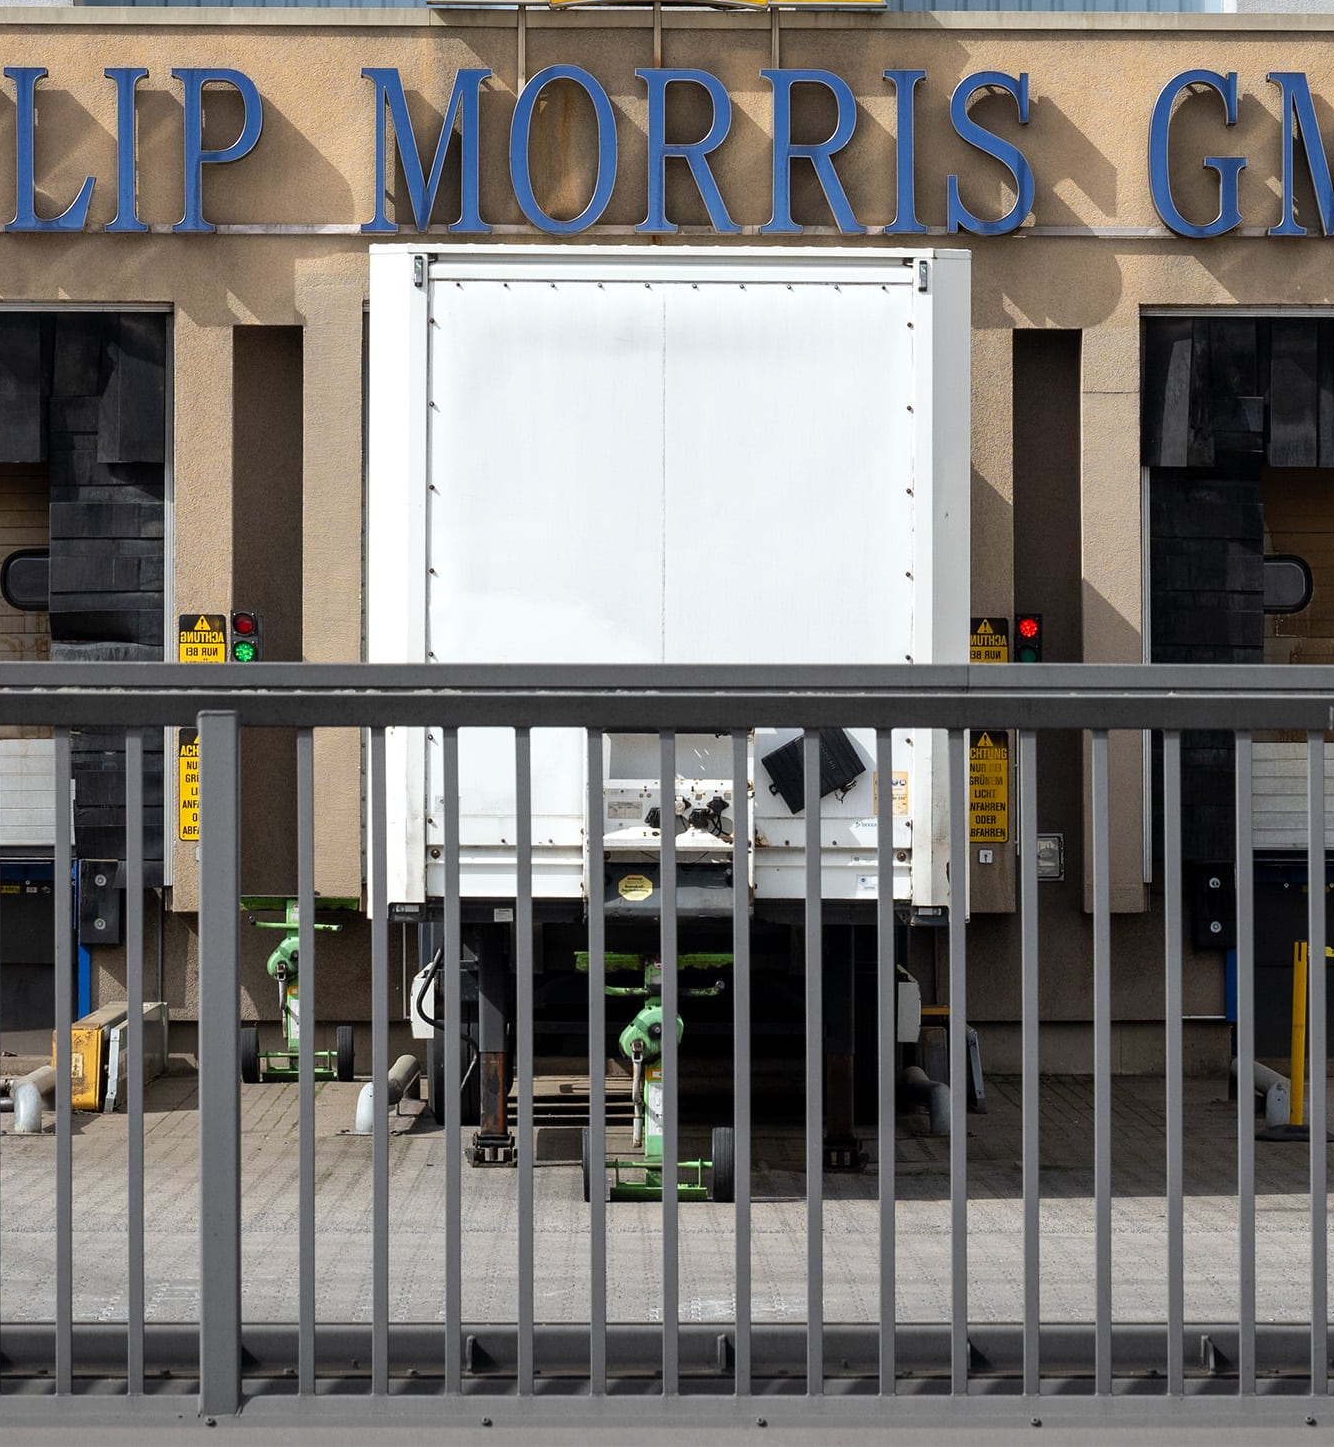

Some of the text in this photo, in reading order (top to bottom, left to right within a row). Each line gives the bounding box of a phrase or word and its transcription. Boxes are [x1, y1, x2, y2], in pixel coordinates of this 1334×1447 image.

[360, 64, 1037, 237] MORRIS
[970, 747, 1007, 759] CHTUNG
[974, 789, 996, 798] LICHT
[970, 802, 1006, 811] NFAHREN
[975, 815, 996, 824] ODER
[970, 828, 1006, 837] BFAHREN
